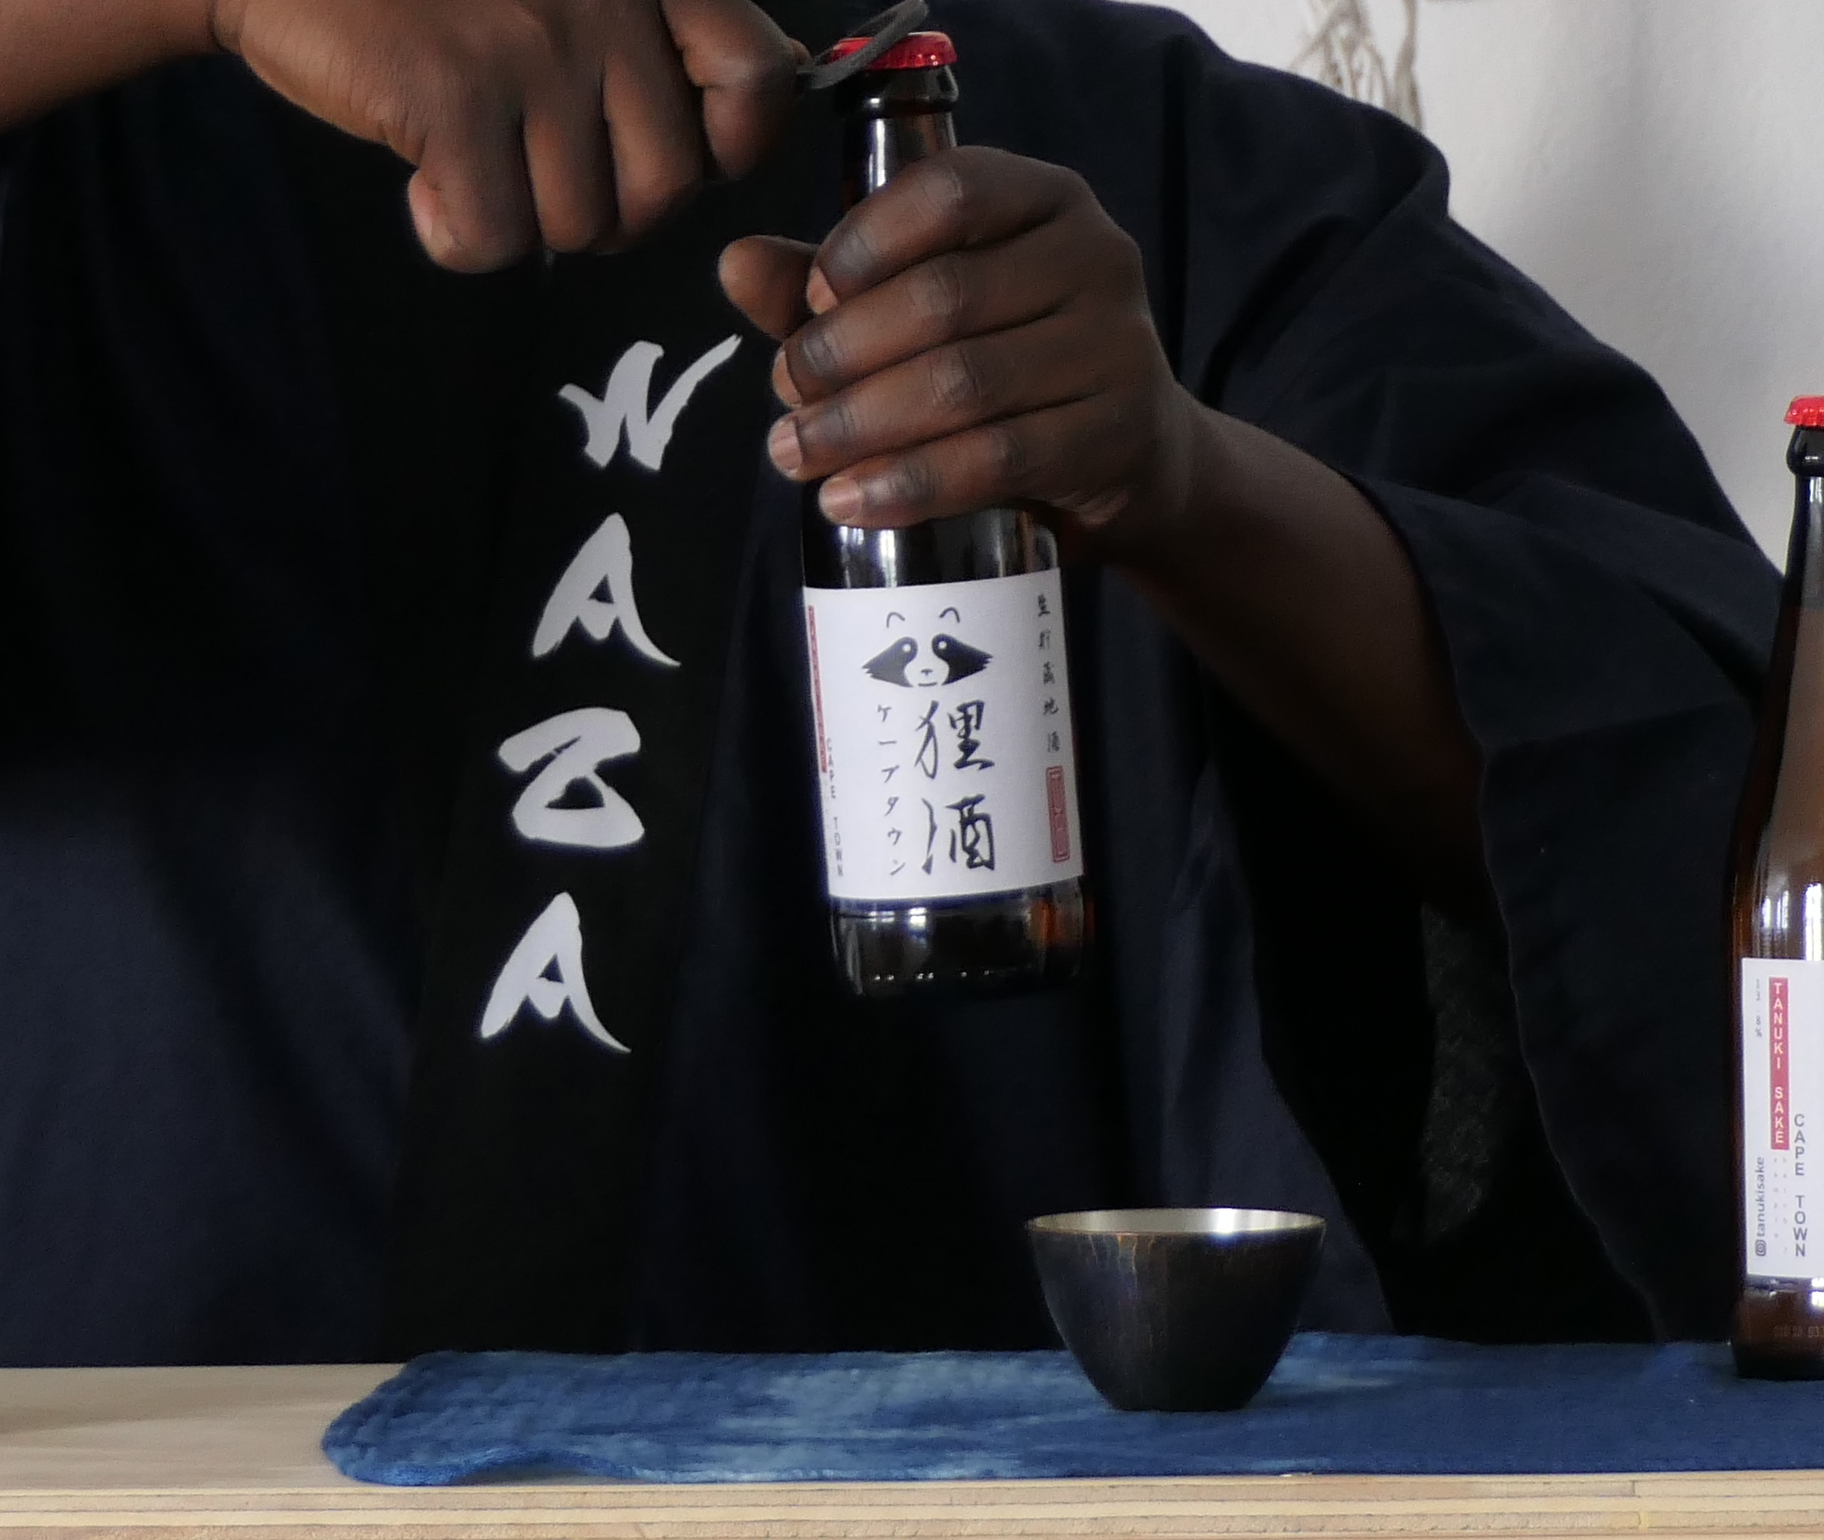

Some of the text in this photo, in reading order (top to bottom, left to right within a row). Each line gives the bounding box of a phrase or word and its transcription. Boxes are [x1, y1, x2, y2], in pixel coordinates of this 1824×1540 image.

[477, 333, 742, 1054] WAZA
[1773, 982, 1785, 1144] TANUKI SAKE
[1754, 1156, 1766, 1237] tanukisake
[1793, 1113, 1808, 1257] CAPE TOWN
